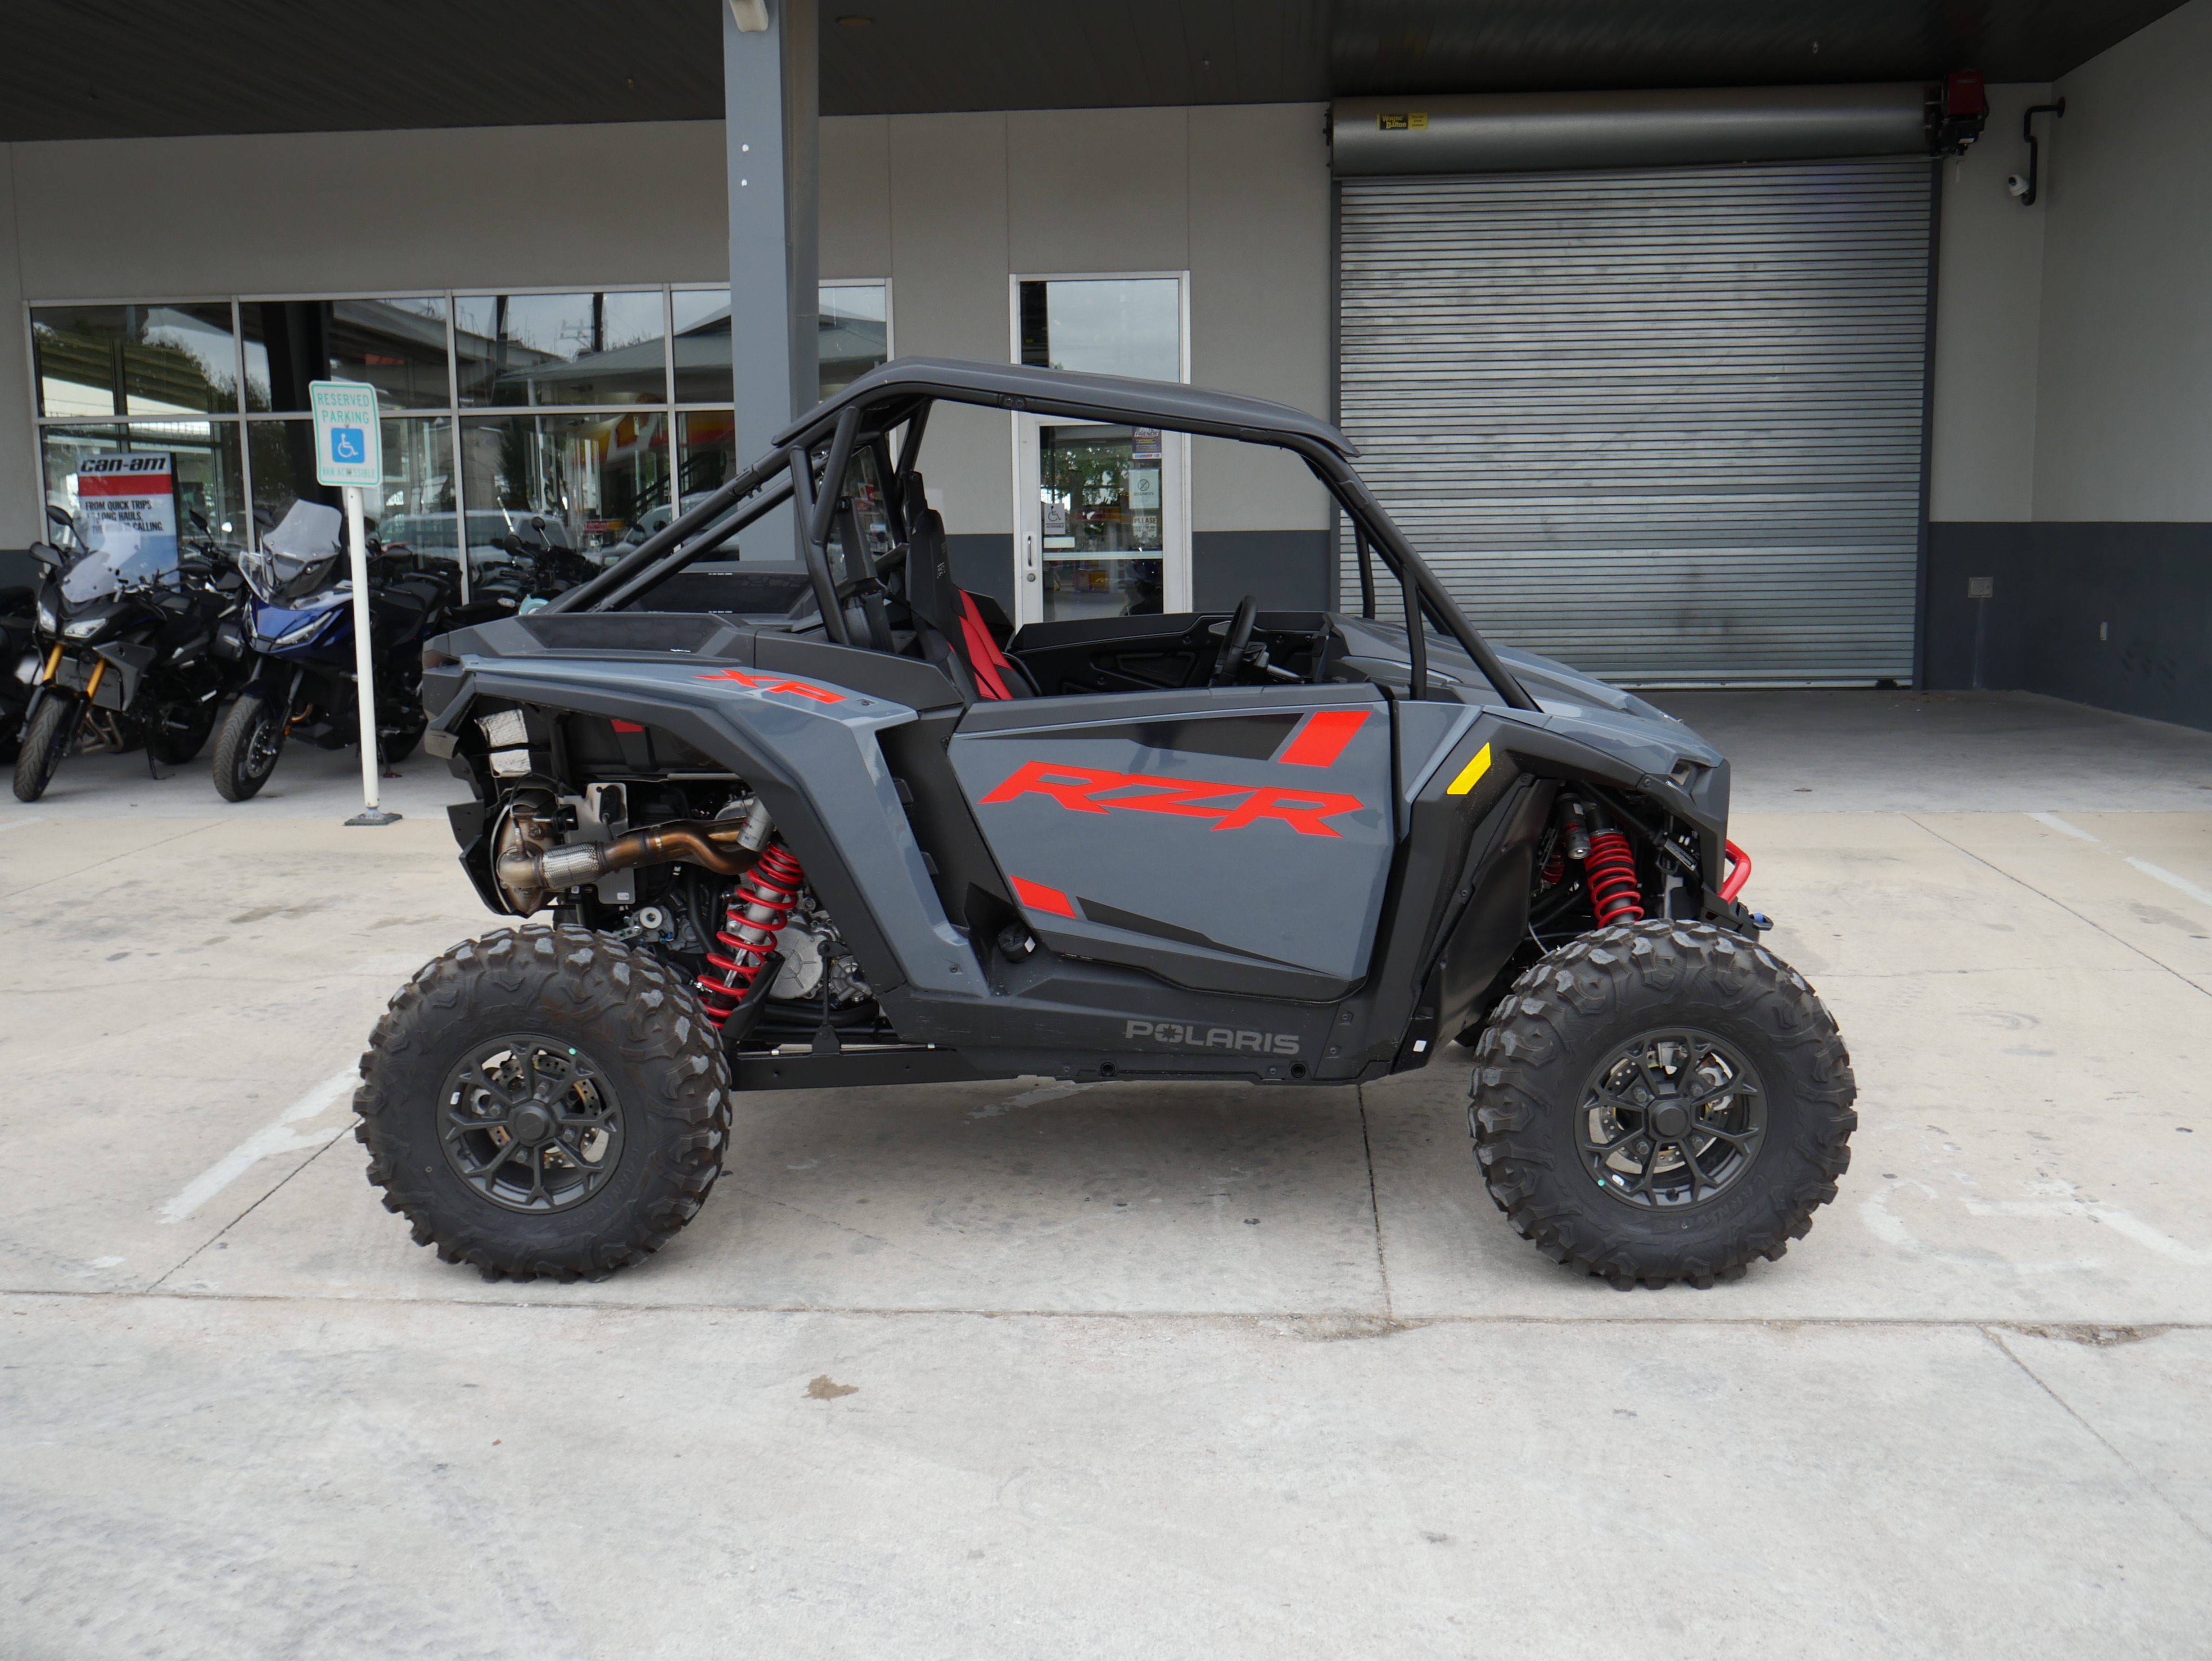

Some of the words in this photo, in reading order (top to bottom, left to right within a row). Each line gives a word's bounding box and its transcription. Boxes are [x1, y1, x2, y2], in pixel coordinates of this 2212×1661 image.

[317, 393, 369, 407] RESERVED
[322, 410, 369, 424] PARKING
[81, 458, 166, 472] can-am
[322, 467, 335, 476] VAN
[85, 501, 105, 511] FROM
[107, 500, 129, 511] QUICK
[132, 499, 153, 510] TRIPS
[691, 669, 848, 704] XP
[977, 761, 1365, 838] RZR
[1125, 1020, 1300, 1055] POLARIS
